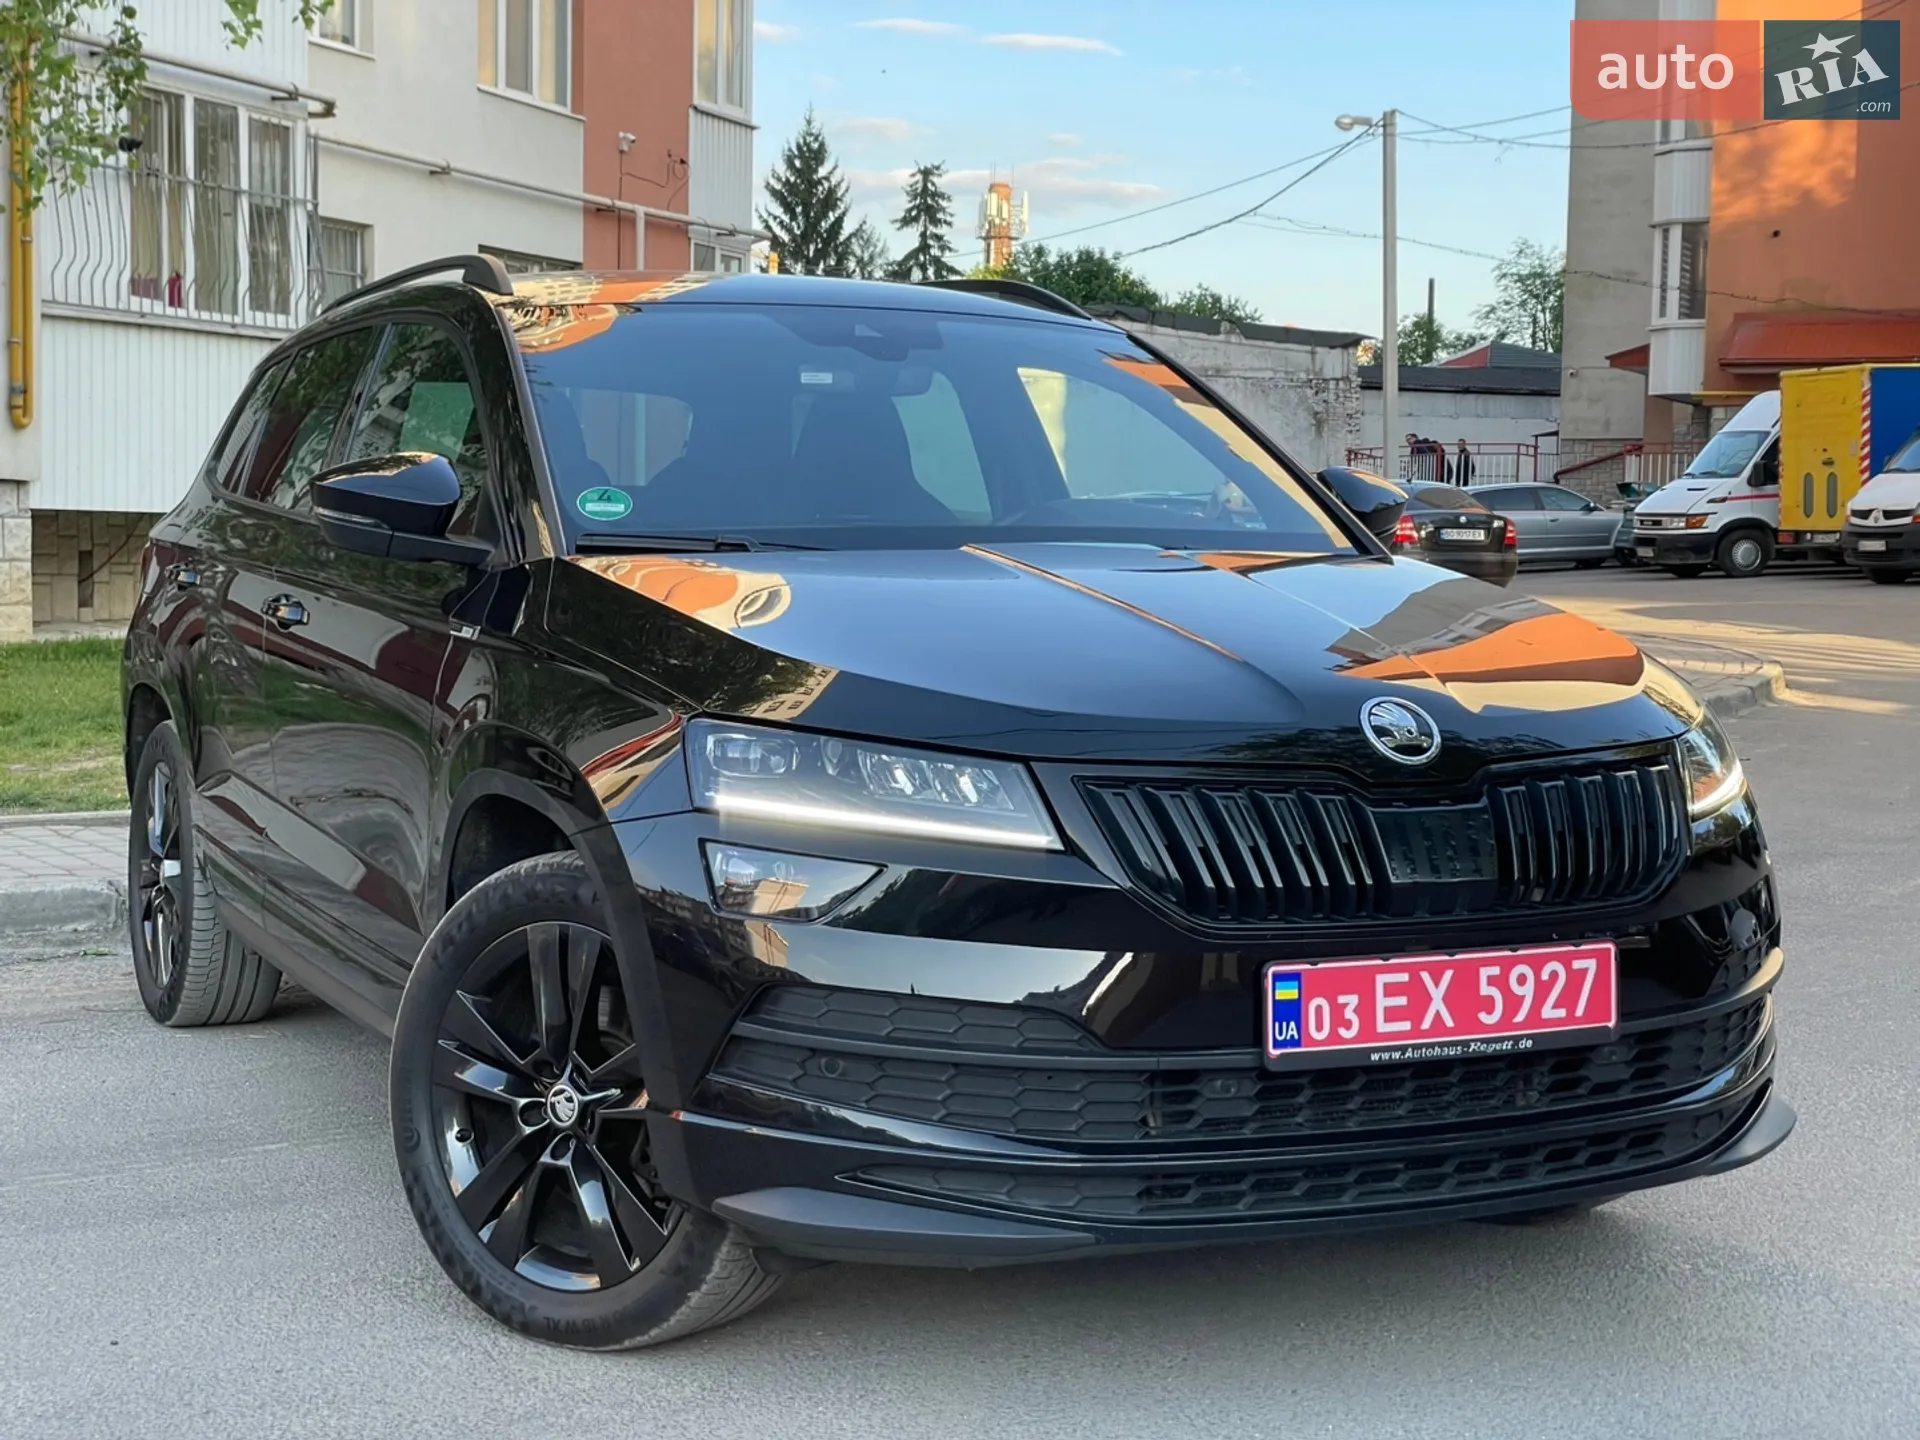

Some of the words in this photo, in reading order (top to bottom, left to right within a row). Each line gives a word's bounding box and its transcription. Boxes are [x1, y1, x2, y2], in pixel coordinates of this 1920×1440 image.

[1307, 994, 1360, 1041] 03
[1375, 969, 1455, 1033] EX
[1477, 958, 1597, 1026] 5927
[1274, 1021, 1299, 1041] UA
